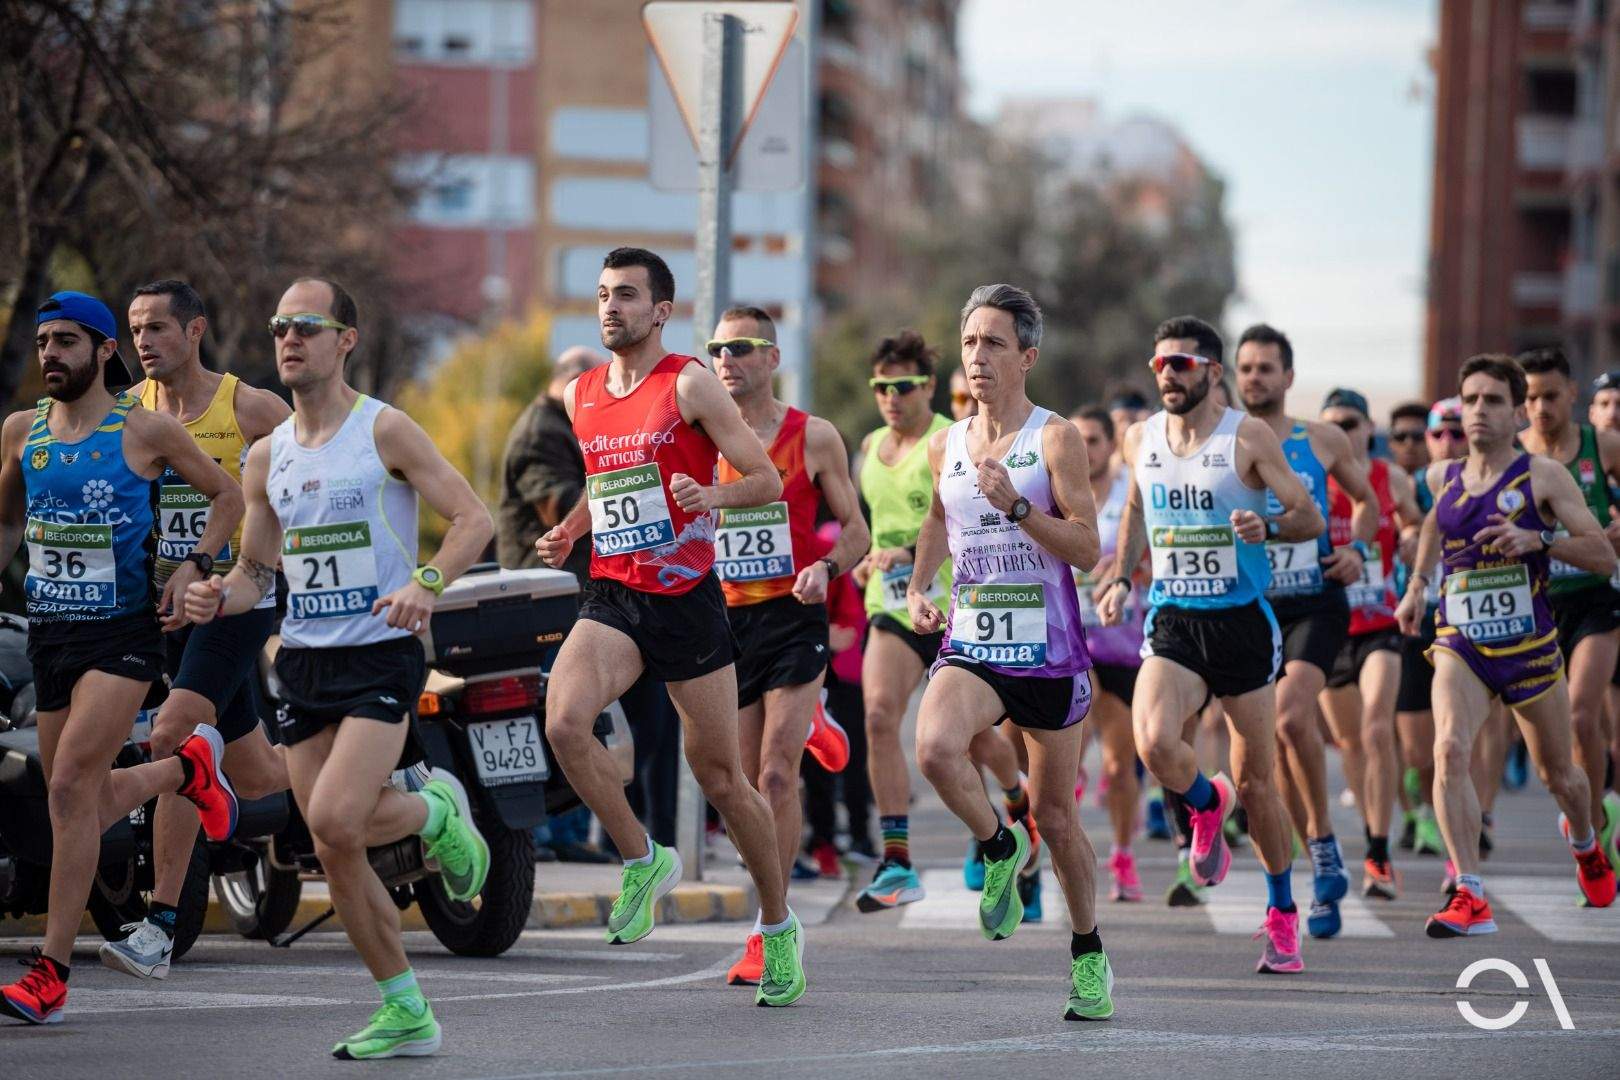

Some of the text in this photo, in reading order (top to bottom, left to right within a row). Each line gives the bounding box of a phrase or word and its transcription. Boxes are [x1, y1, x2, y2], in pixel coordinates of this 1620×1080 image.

[598, 449, 646, 467] ATTICUS
[600, 473, 655, 491] IBERDROLA
[160, 494, 209, 503] BERDROL
[329, 495, 364, 511] TEAM
[1152, 483, 1214, 510] Delta
[603, 496, 641, 528] 50
[725, 510, 782, 524] IBERDROLA
[168, 511, 206, 539] 46
[999, 525, 1020, 533] ALBACE
[44, 530, 106, 543] IBERDROLA
[301, 530, 365, 546] IBERDROLA
[718, 528, 775, 557] 128
[1174, 533, 1229, 543] IBERDROLA
[158, 541, 199, 559] om
[973, 543, 1017, 555] FARMACIA
[43, 550, 87, 578] 36
[994, 553, 1046, 573] TERESA
[1167, 550, 1221, 575] 136
[303, 555, 340, 589] 21
[978, 592, 1040, 603] IBERDROLA
[1461, 591, 1516, 620] 149
[976, 612, 1013, 641] 91
[483, 746, 537, 772] 9429
